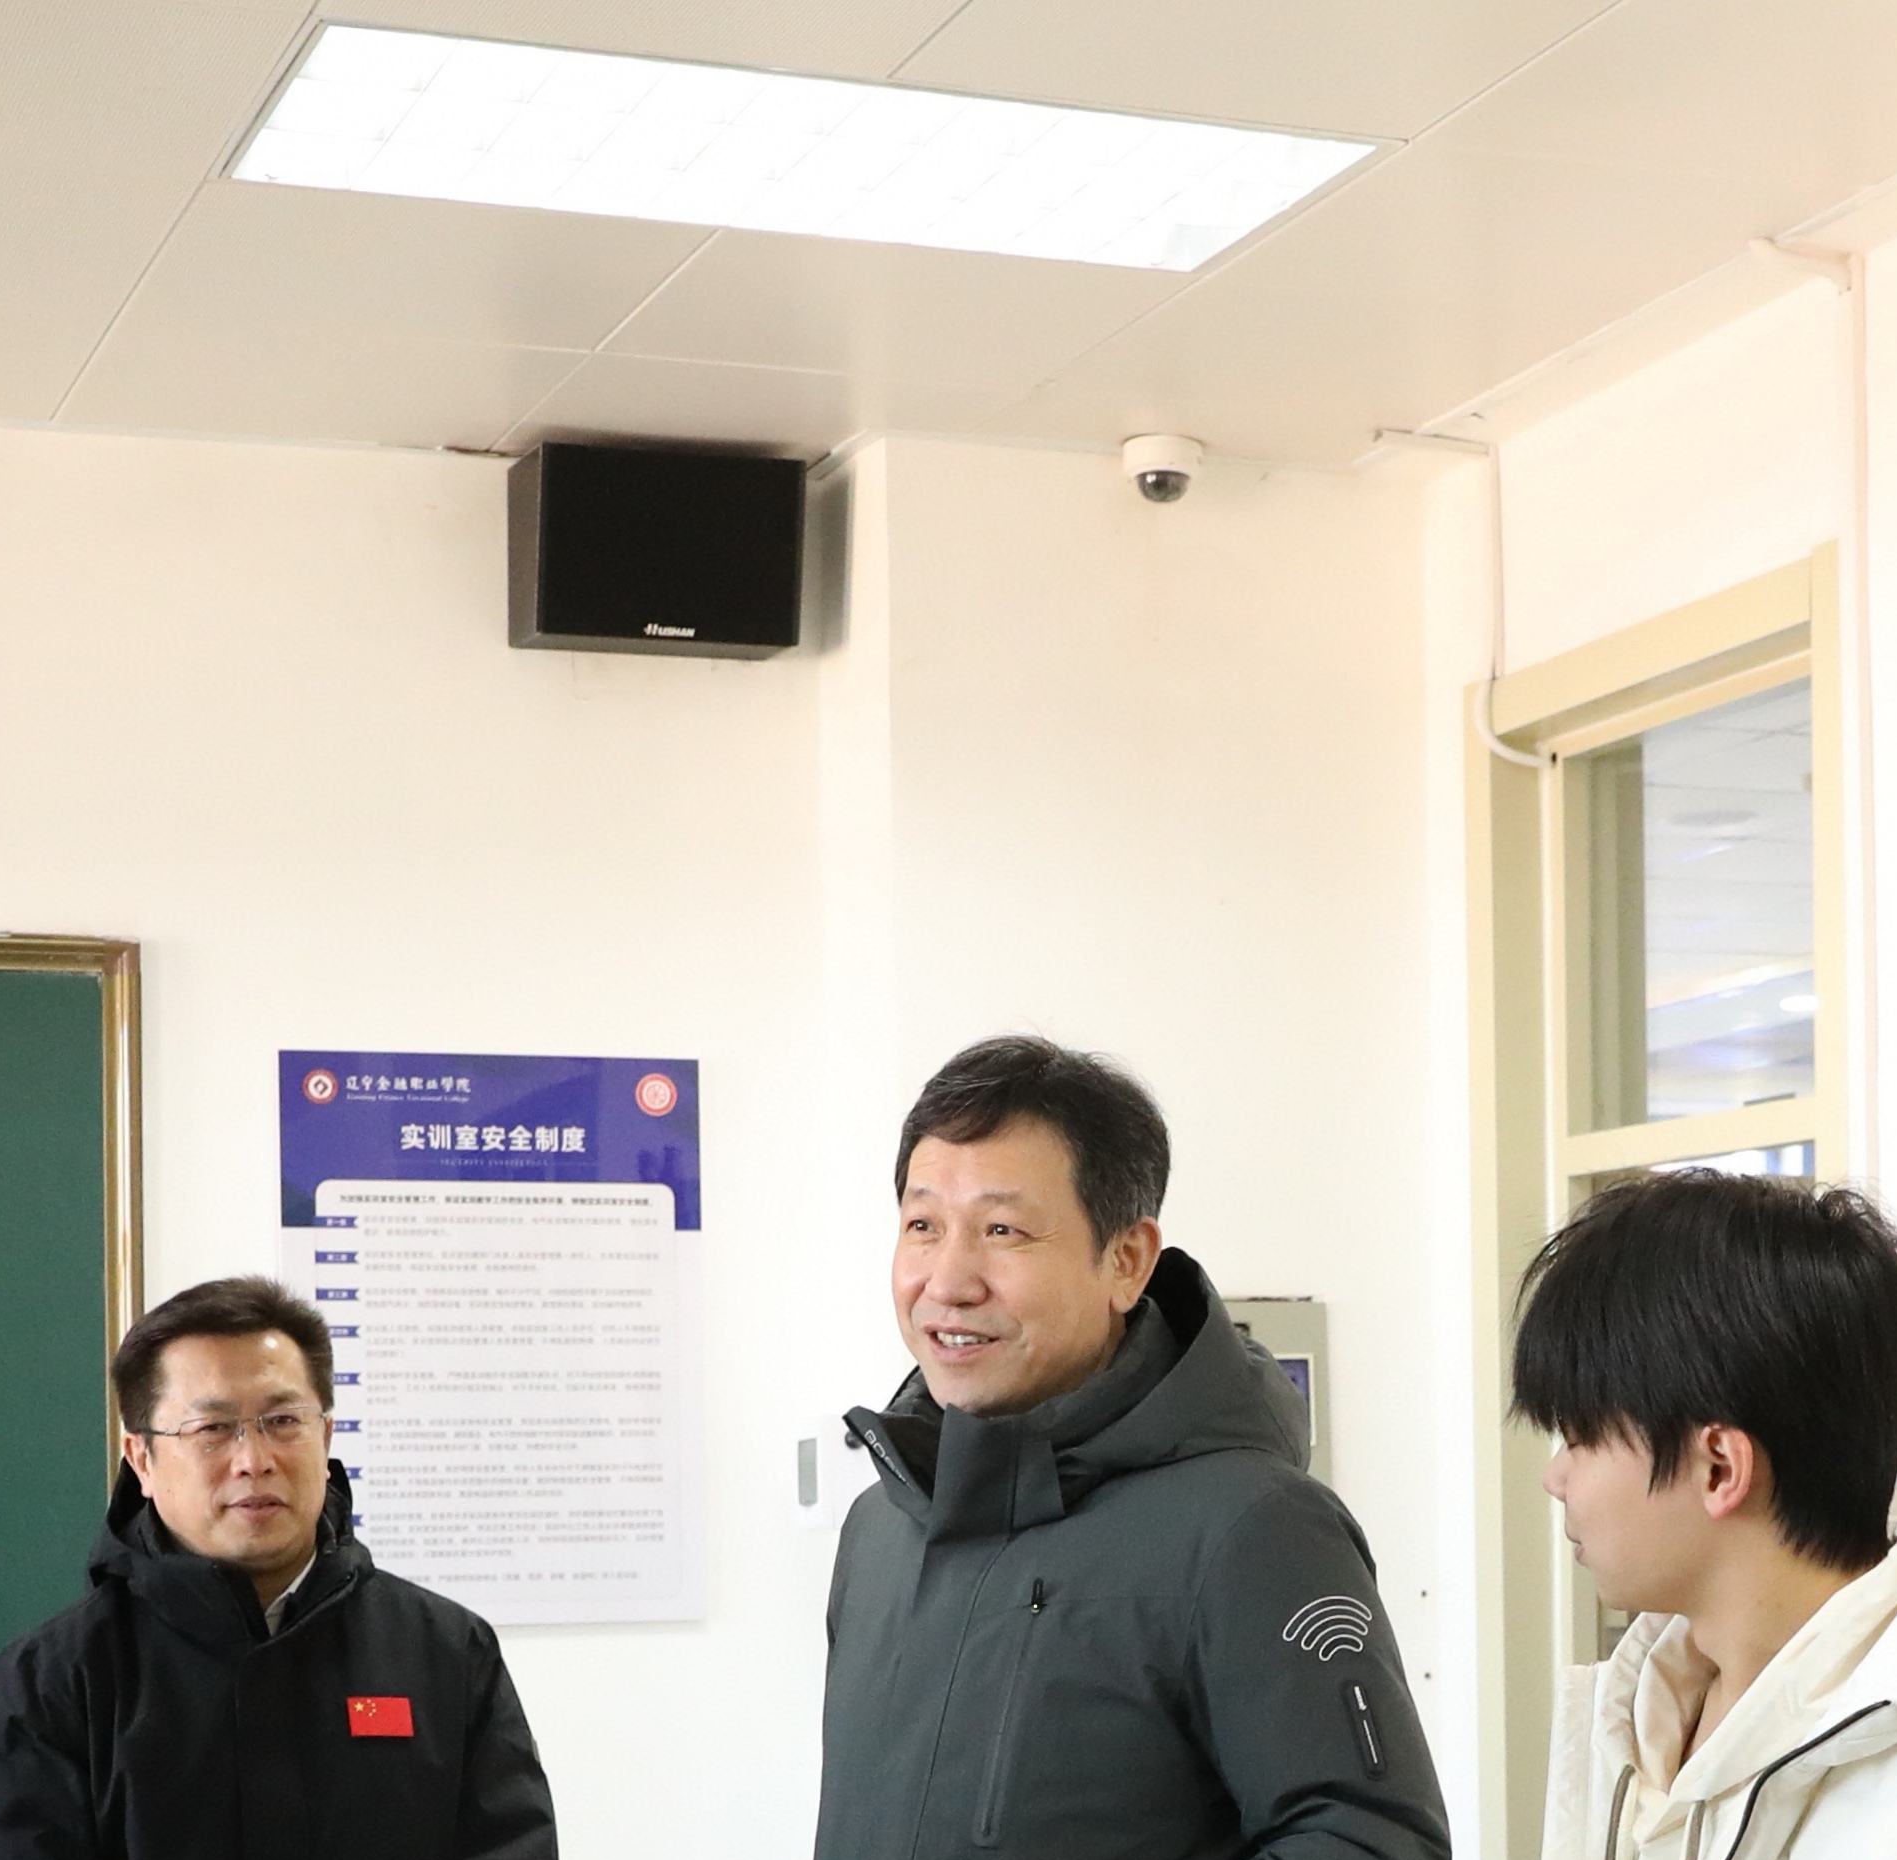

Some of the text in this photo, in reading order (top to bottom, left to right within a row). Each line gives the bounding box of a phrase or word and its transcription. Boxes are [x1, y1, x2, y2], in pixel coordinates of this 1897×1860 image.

[400, 1123, 587, 1153] 实训室安全制度
